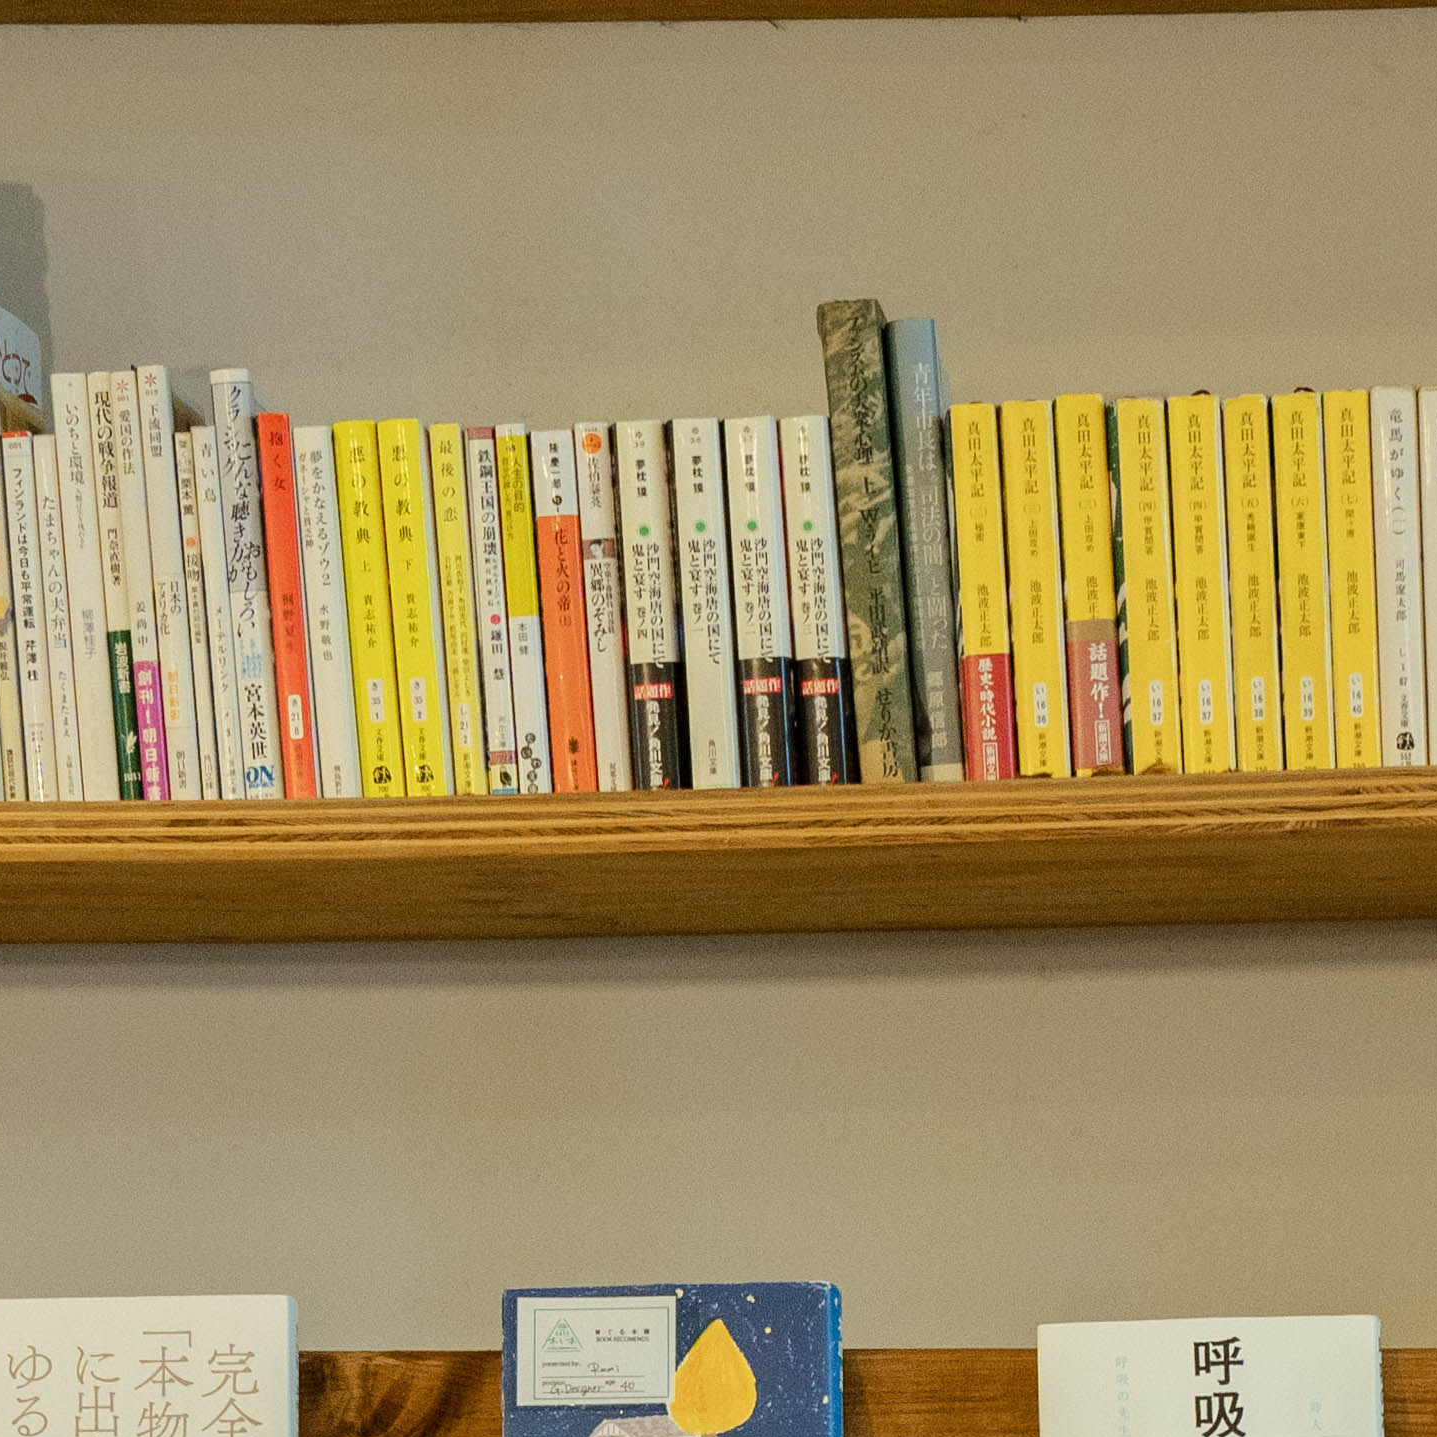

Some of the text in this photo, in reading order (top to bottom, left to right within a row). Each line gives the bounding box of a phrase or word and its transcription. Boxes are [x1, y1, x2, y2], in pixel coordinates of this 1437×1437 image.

[269, 432, 287, 491] 抱く女
[1138, 415, 1155, 492] 真田太平記
[1389, 410, 1404, 500] 竜馬がゆく
[1145, 578, 1161, 641] 池波正太郎
